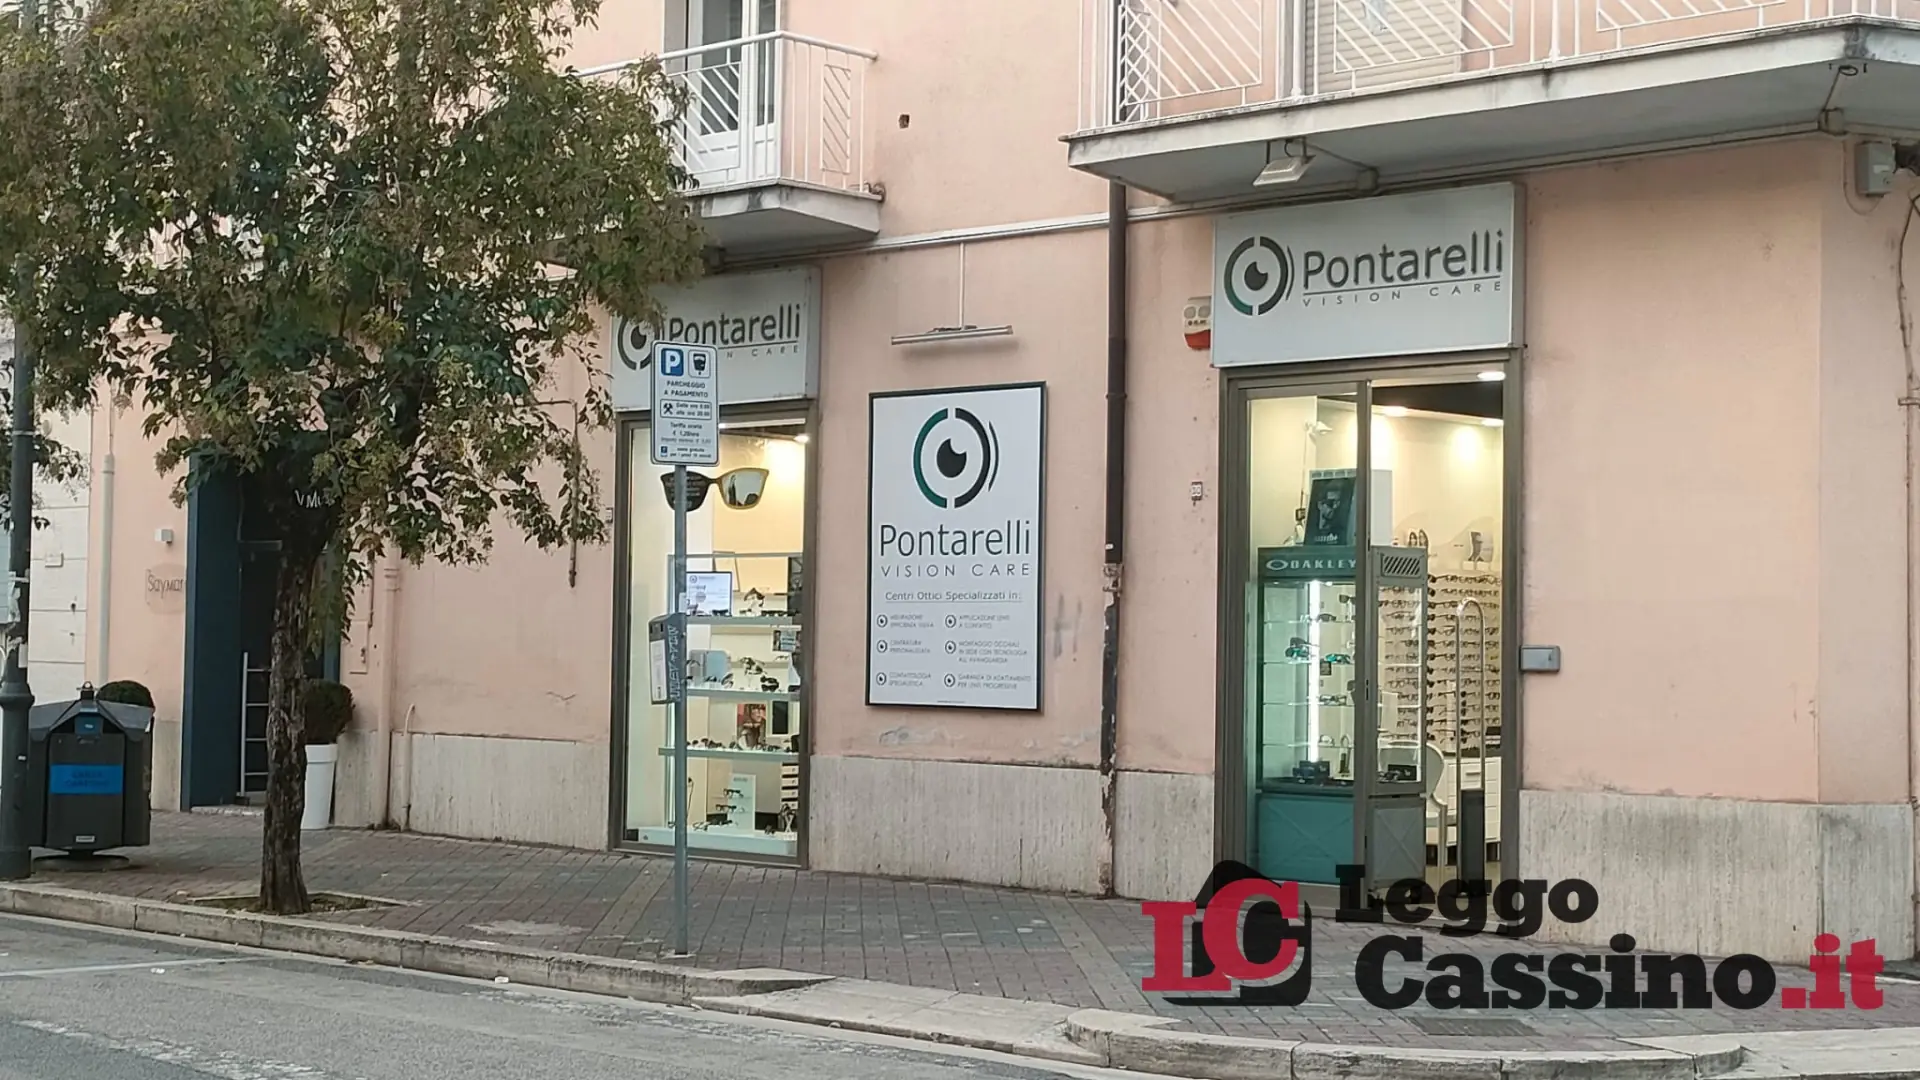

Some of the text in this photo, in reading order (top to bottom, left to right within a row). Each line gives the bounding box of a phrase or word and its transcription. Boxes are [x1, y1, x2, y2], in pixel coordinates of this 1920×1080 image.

[1303, 229, 1503, 290] Pontarelli
[1303, 281, 1501, 307] VISION CARE
[669, 303, 800, 346] Pontarelli
[667, 380, 706, 389] PARCHEGGIO
[671, 390, 708, 398] PAGAMENTO
[881, 520, 1030, 557] Pontarelli
[881, 563, 1031, 577] VISION CARE
[1290, 559, 1357, 569] OAKLEY
[885, 591, 1022, 602] Centri Ottici Specializzati in:
